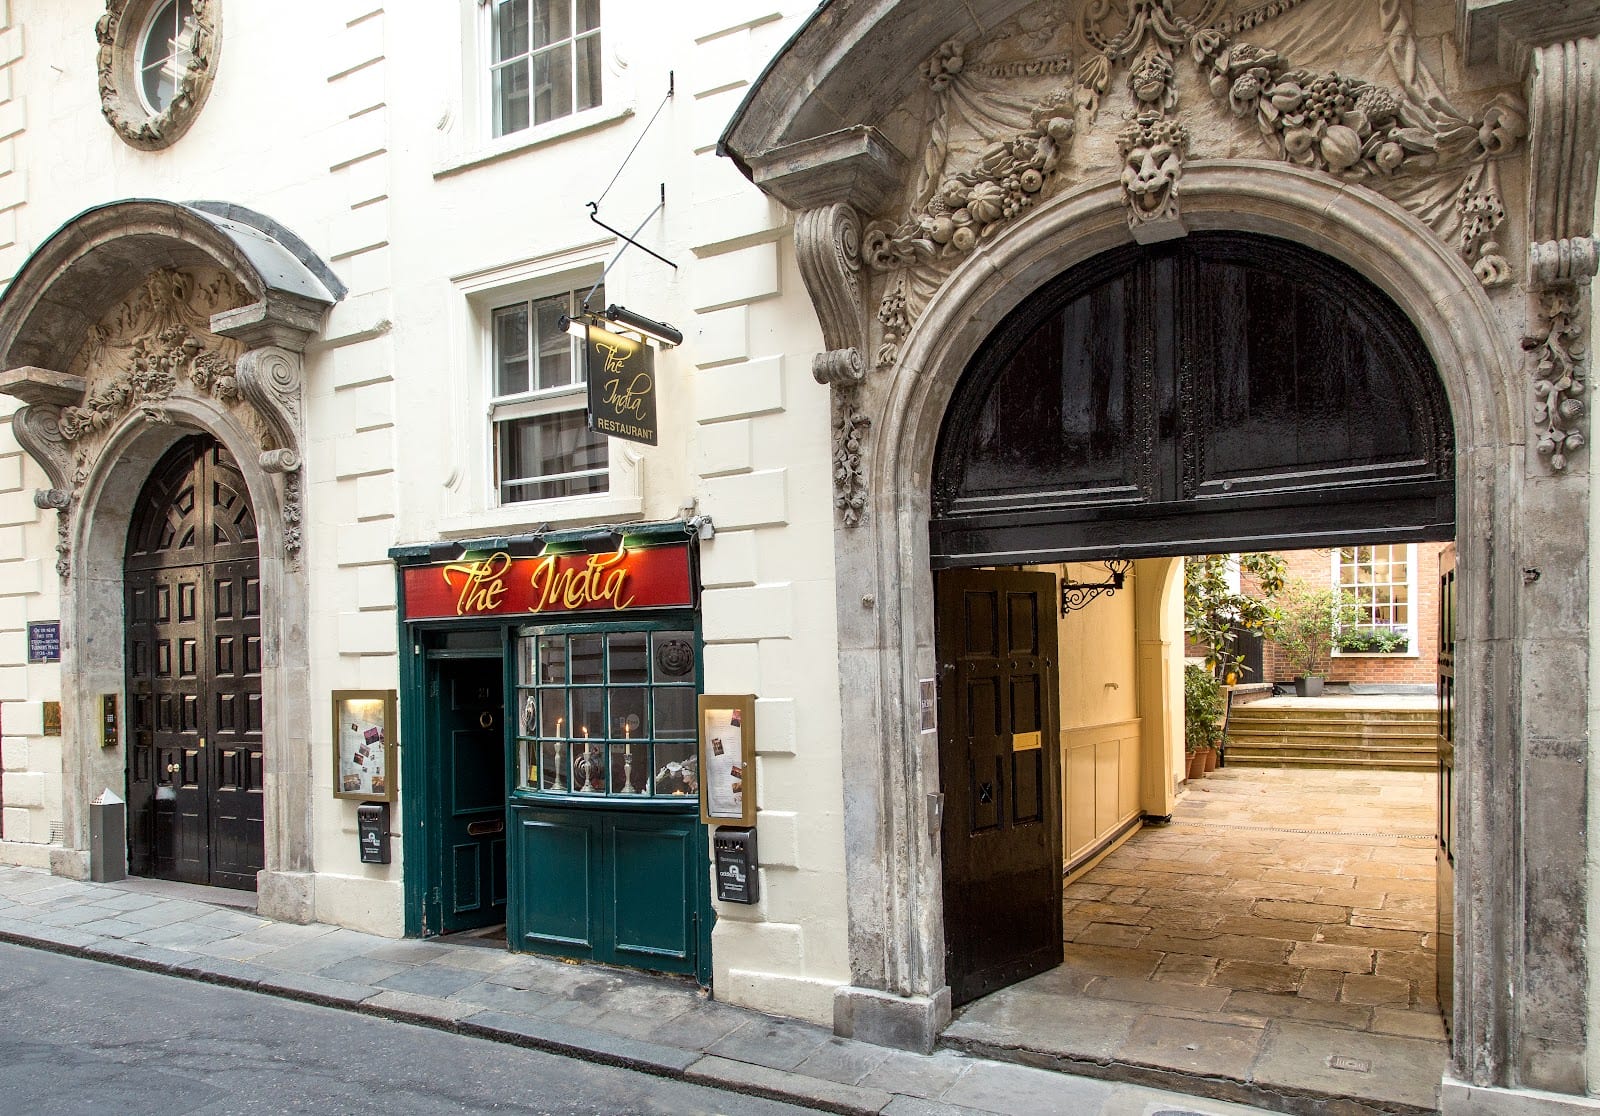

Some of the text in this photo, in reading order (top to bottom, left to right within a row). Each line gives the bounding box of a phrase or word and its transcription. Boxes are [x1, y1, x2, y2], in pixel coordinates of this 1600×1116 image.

[596, 342, 632, 373] The
[603, 373, 652, 420] India
[597, 417, 654, 440] RESTAURANT
[443, 549, 634, 616] The India
